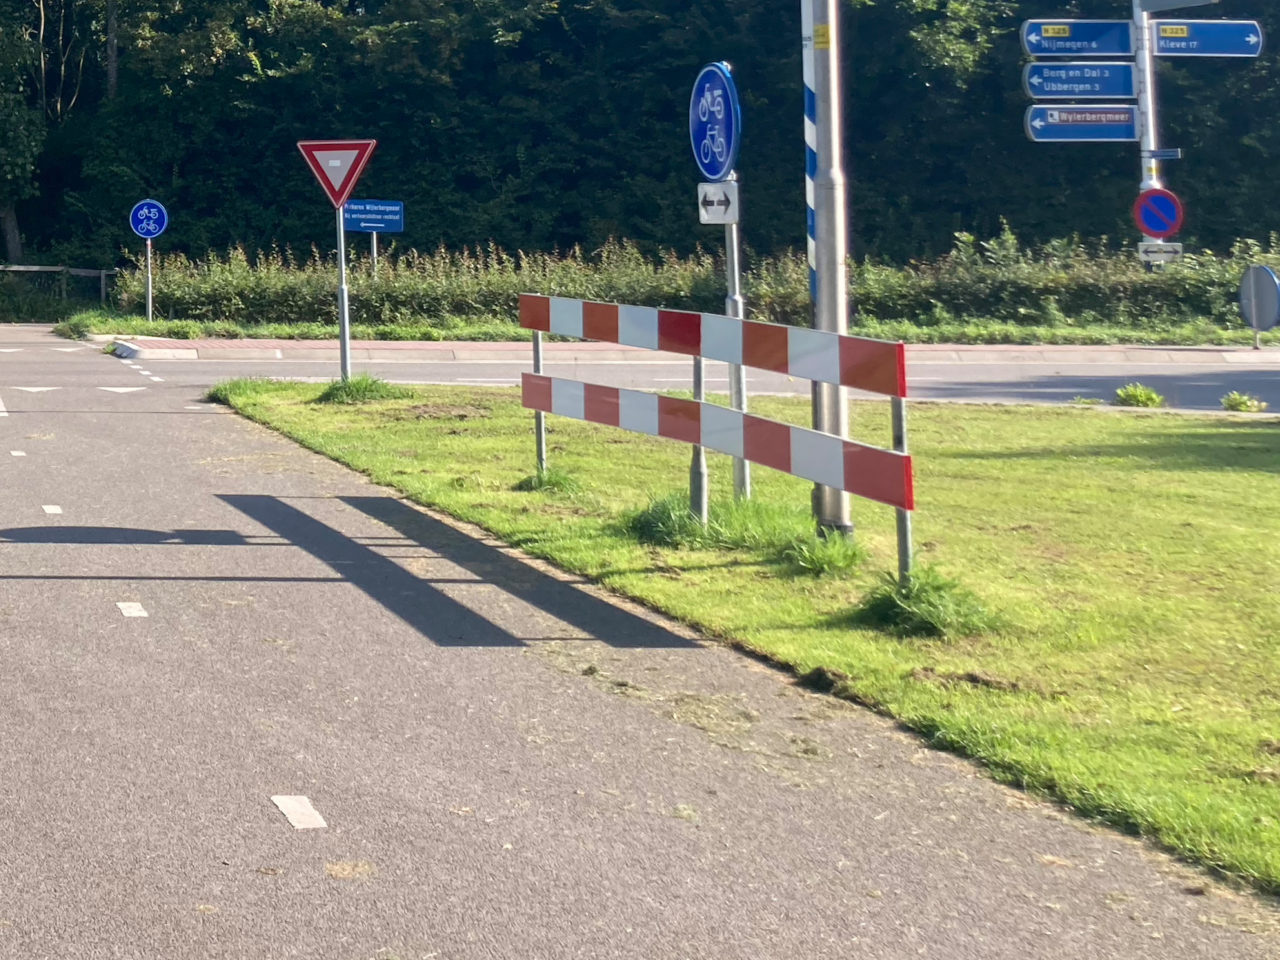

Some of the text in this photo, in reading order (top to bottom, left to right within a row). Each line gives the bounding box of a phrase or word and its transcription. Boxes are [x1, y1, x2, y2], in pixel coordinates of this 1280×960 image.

[1041, 40, 1089, 50] Nijmegen
[1159, 40, 1187, 48] Kleve
[1043, 69, 1066, 79] Berg
[1084, 69, 1100, 77] Dal
[1044, 83, 1091, 93] Ubbergen
[1059, 112, 1129, 123] Wylerbergmeer
